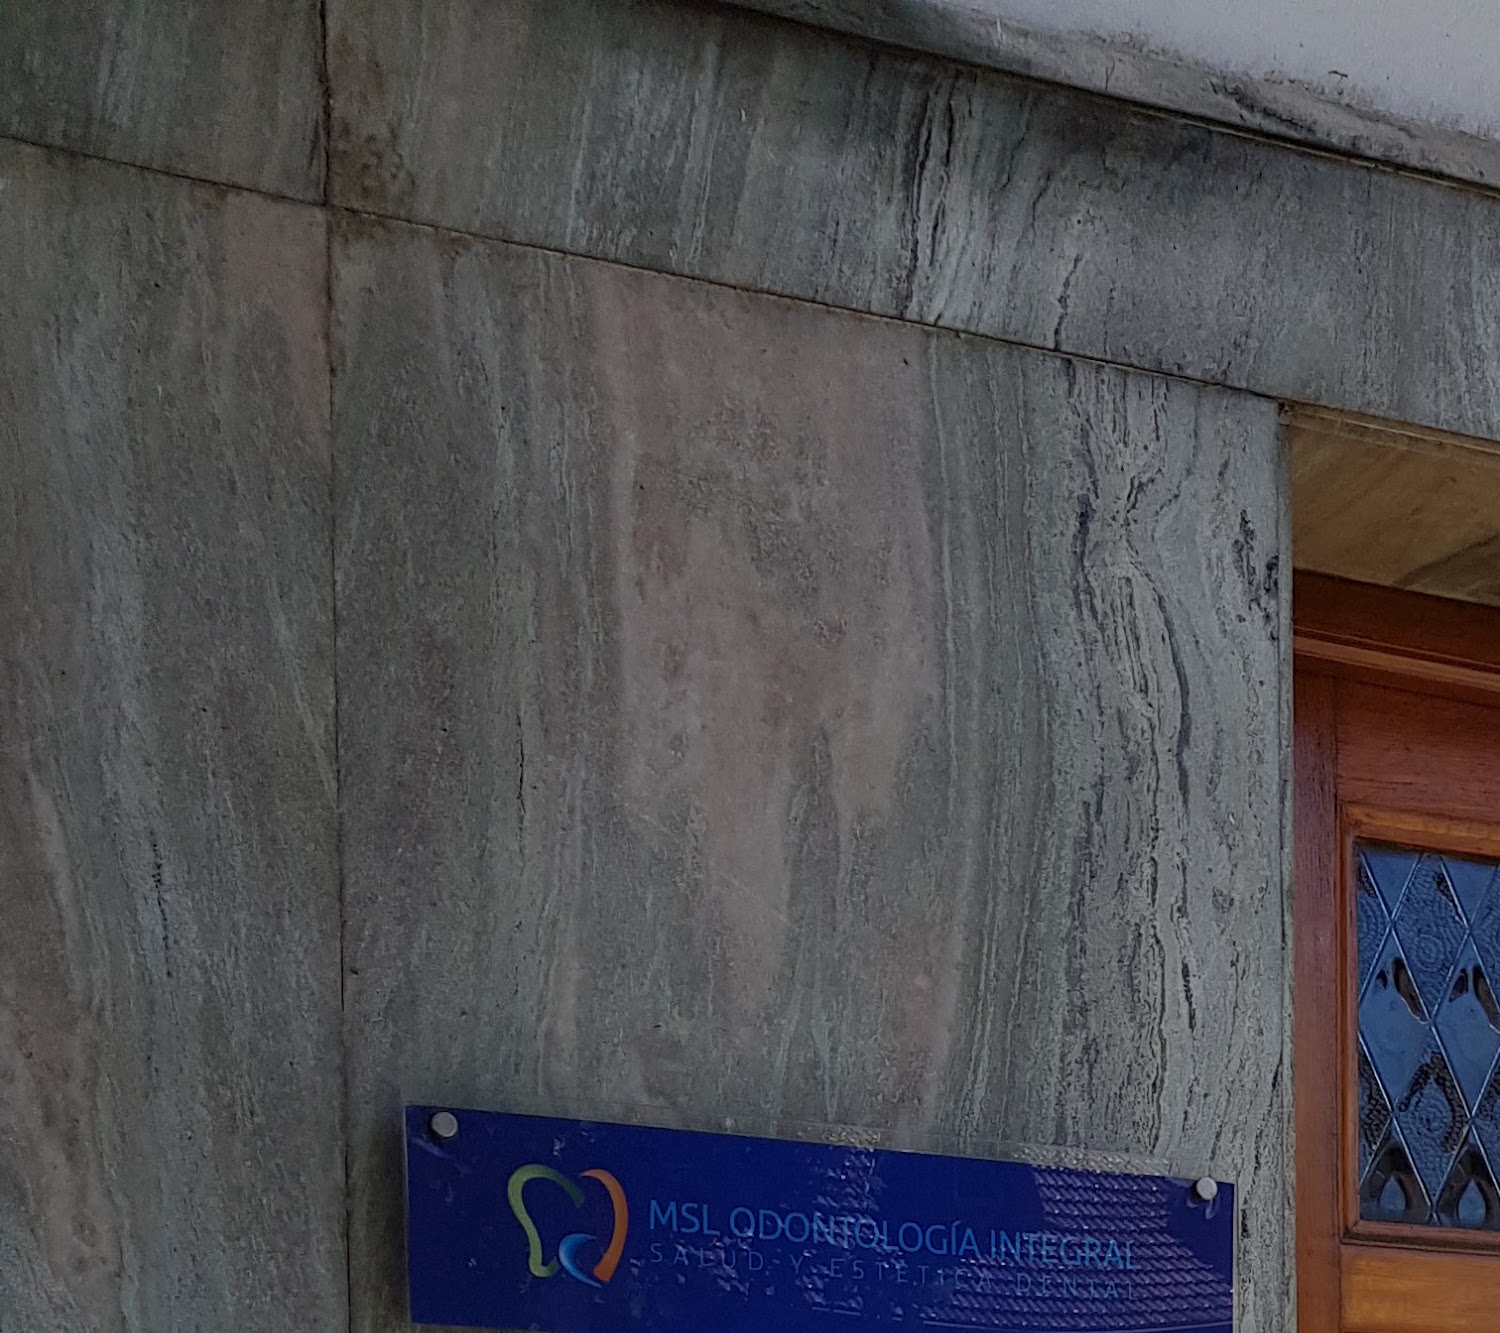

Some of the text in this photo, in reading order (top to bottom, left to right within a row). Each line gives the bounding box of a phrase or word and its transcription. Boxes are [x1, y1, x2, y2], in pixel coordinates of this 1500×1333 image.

[649, 1200, 1142, 1271] MSL ODONTOLOGÍA INTEGRAL
[649, 1243, 765, 1272] SALUD
[790, 1255, 804, 1275] Y
[1016, 1273, 1138, 1301] DENTAL
